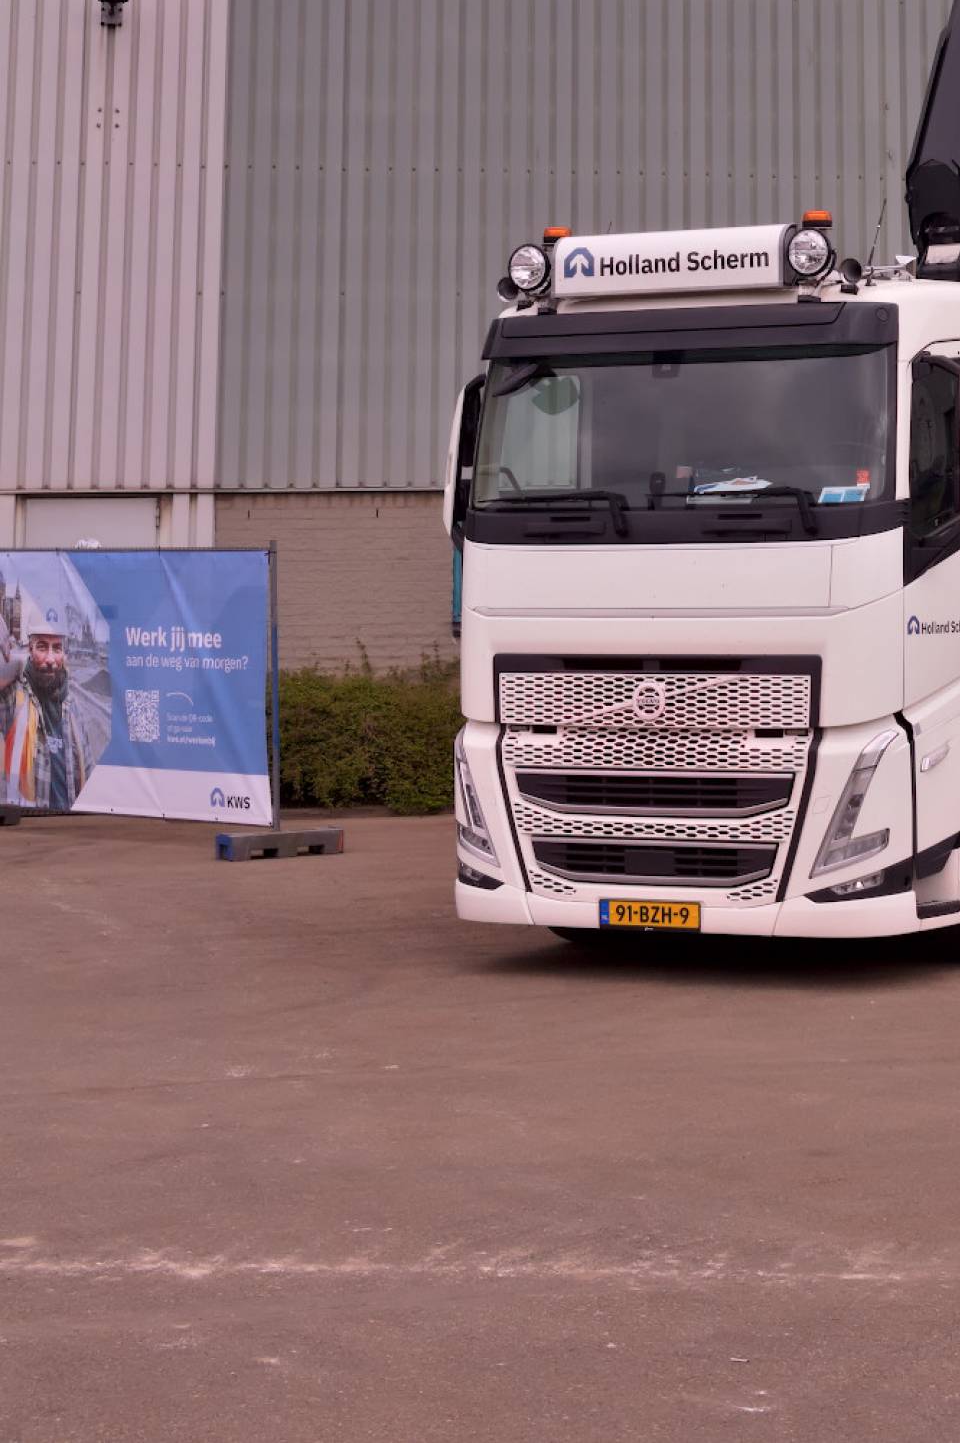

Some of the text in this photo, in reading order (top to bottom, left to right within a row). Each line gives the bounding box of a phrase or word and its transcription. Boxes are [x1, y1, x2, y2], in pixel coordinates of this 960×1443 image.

[600, 247, 770, 277] Holland Scherm
[921, 620, 950, 635] Holland
[126, 626, 222, 653] Werk jij mee
[126, 654, 249, 673] aan de weg van morgen?
[226, 795, 251, 809] KWS
[615, 904, 690, 925] 91-BZH-9
